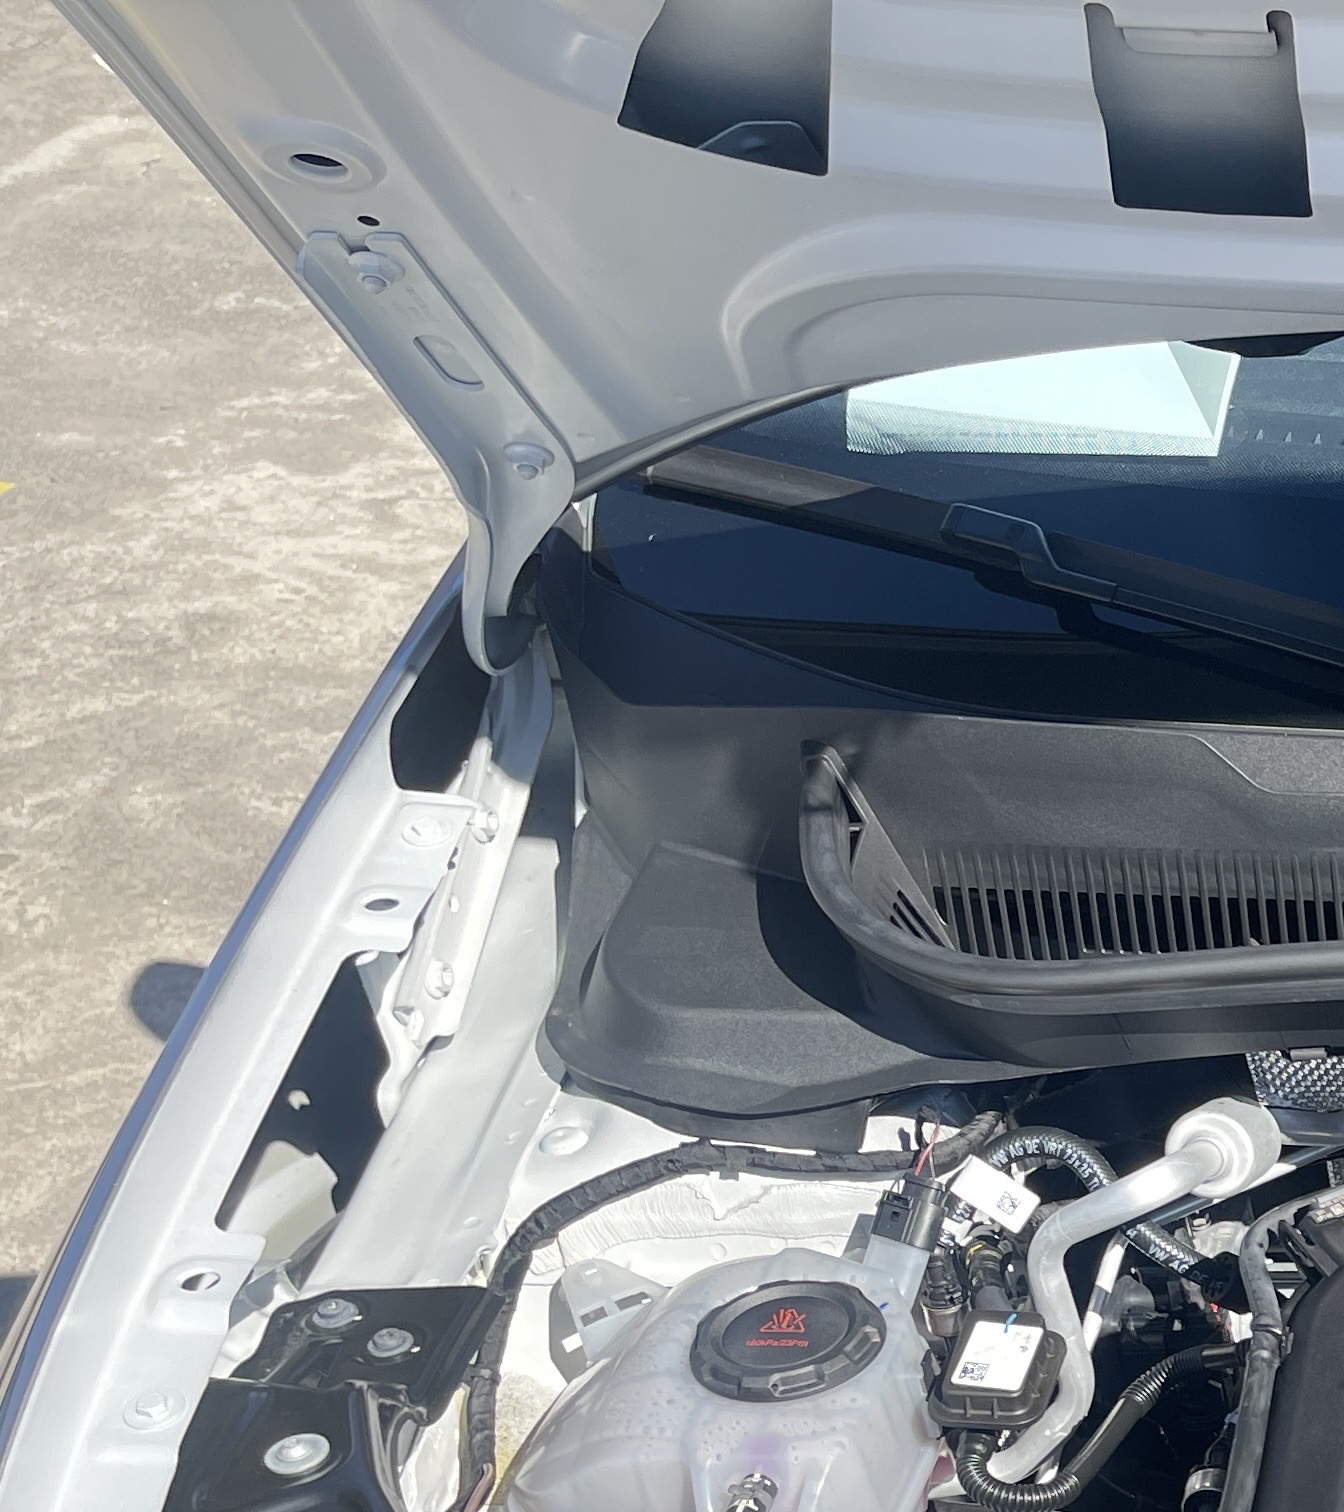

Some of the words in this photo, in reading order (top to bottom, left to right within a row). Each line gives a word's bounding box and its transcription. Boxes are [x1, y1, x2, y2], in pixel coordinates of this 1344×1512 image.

[1009, 1142, 1024, 1158] AG
[1025, 1139, 1040, 1154] DE
[1149, 1245, 1167, 1262] VW
[1169, 1259, 1189, 1274] AG
